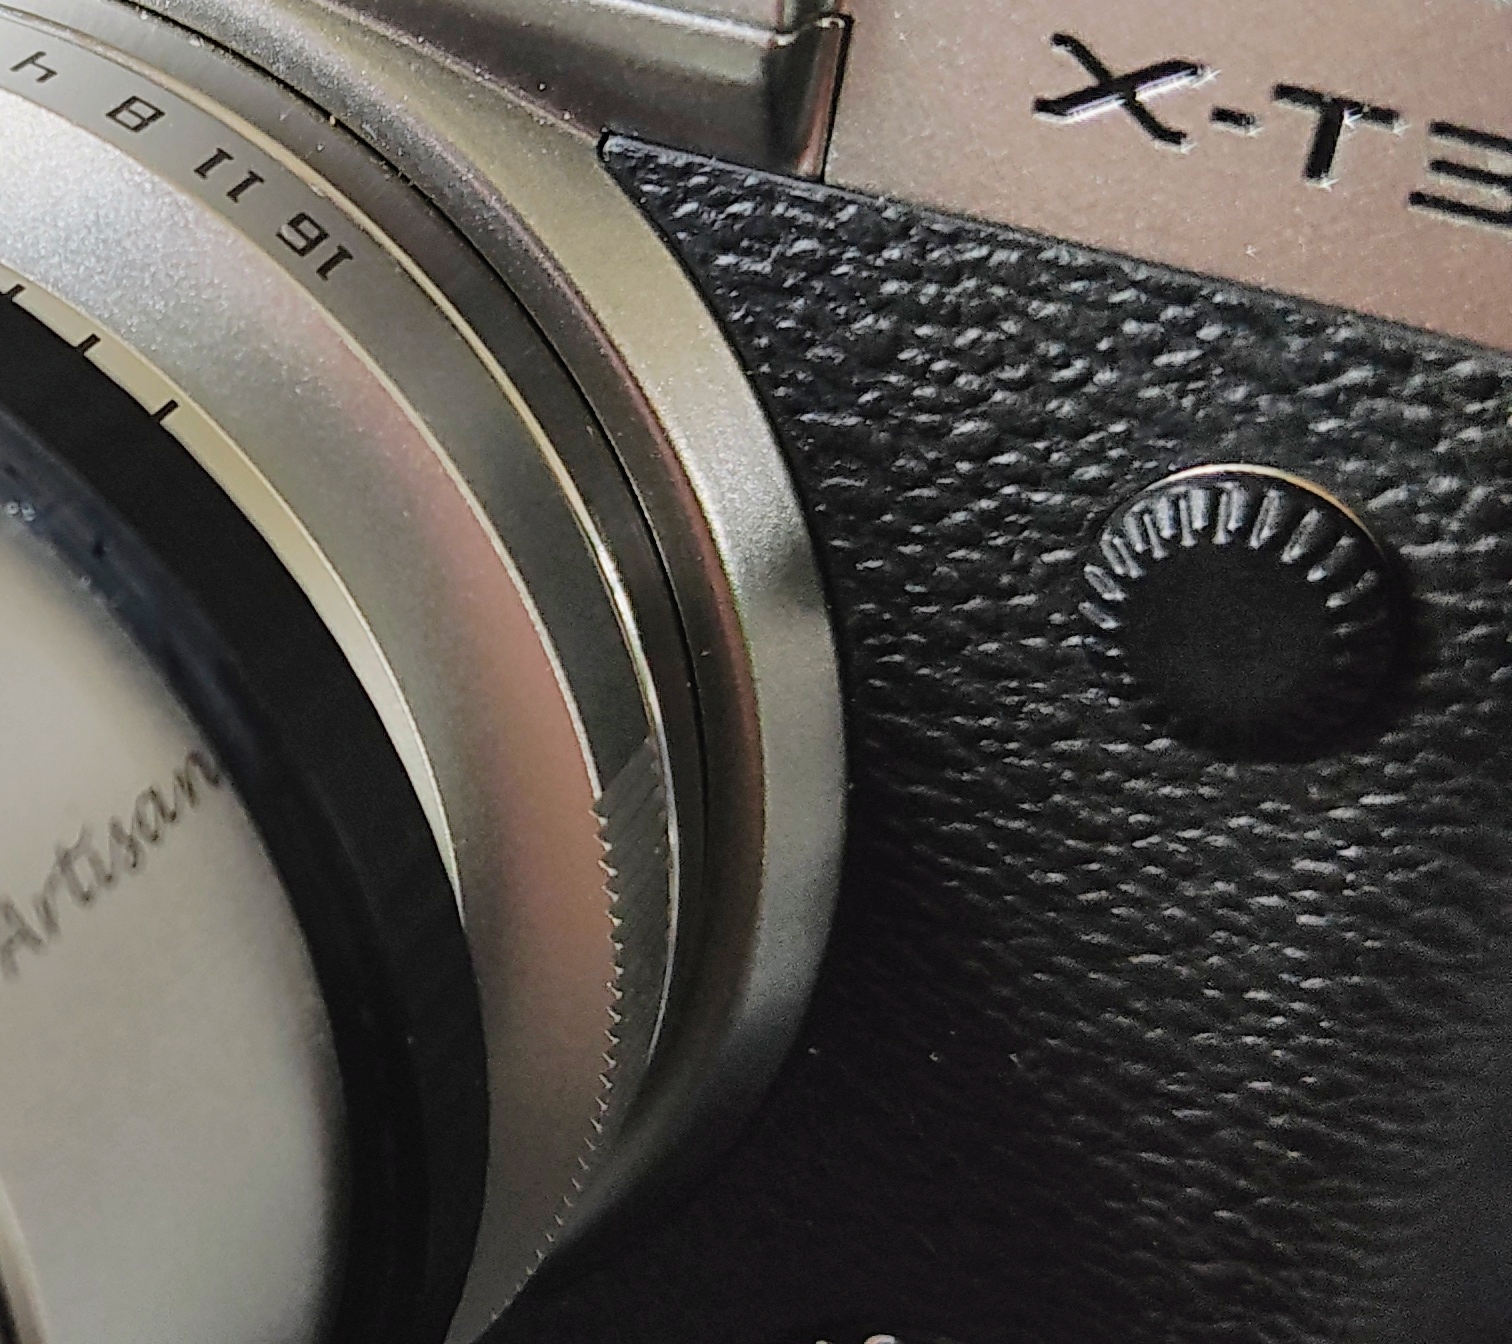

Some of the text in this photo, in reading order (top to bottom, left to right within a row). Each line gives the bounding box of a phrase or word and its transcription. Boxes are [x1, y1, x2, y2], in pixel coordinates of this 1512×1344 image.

[9, 50, 58, 85] 4
[106, 94, 166, 134] 8
[192, 146, 267, 206] 11
[274, 210, 355, 282] 16
